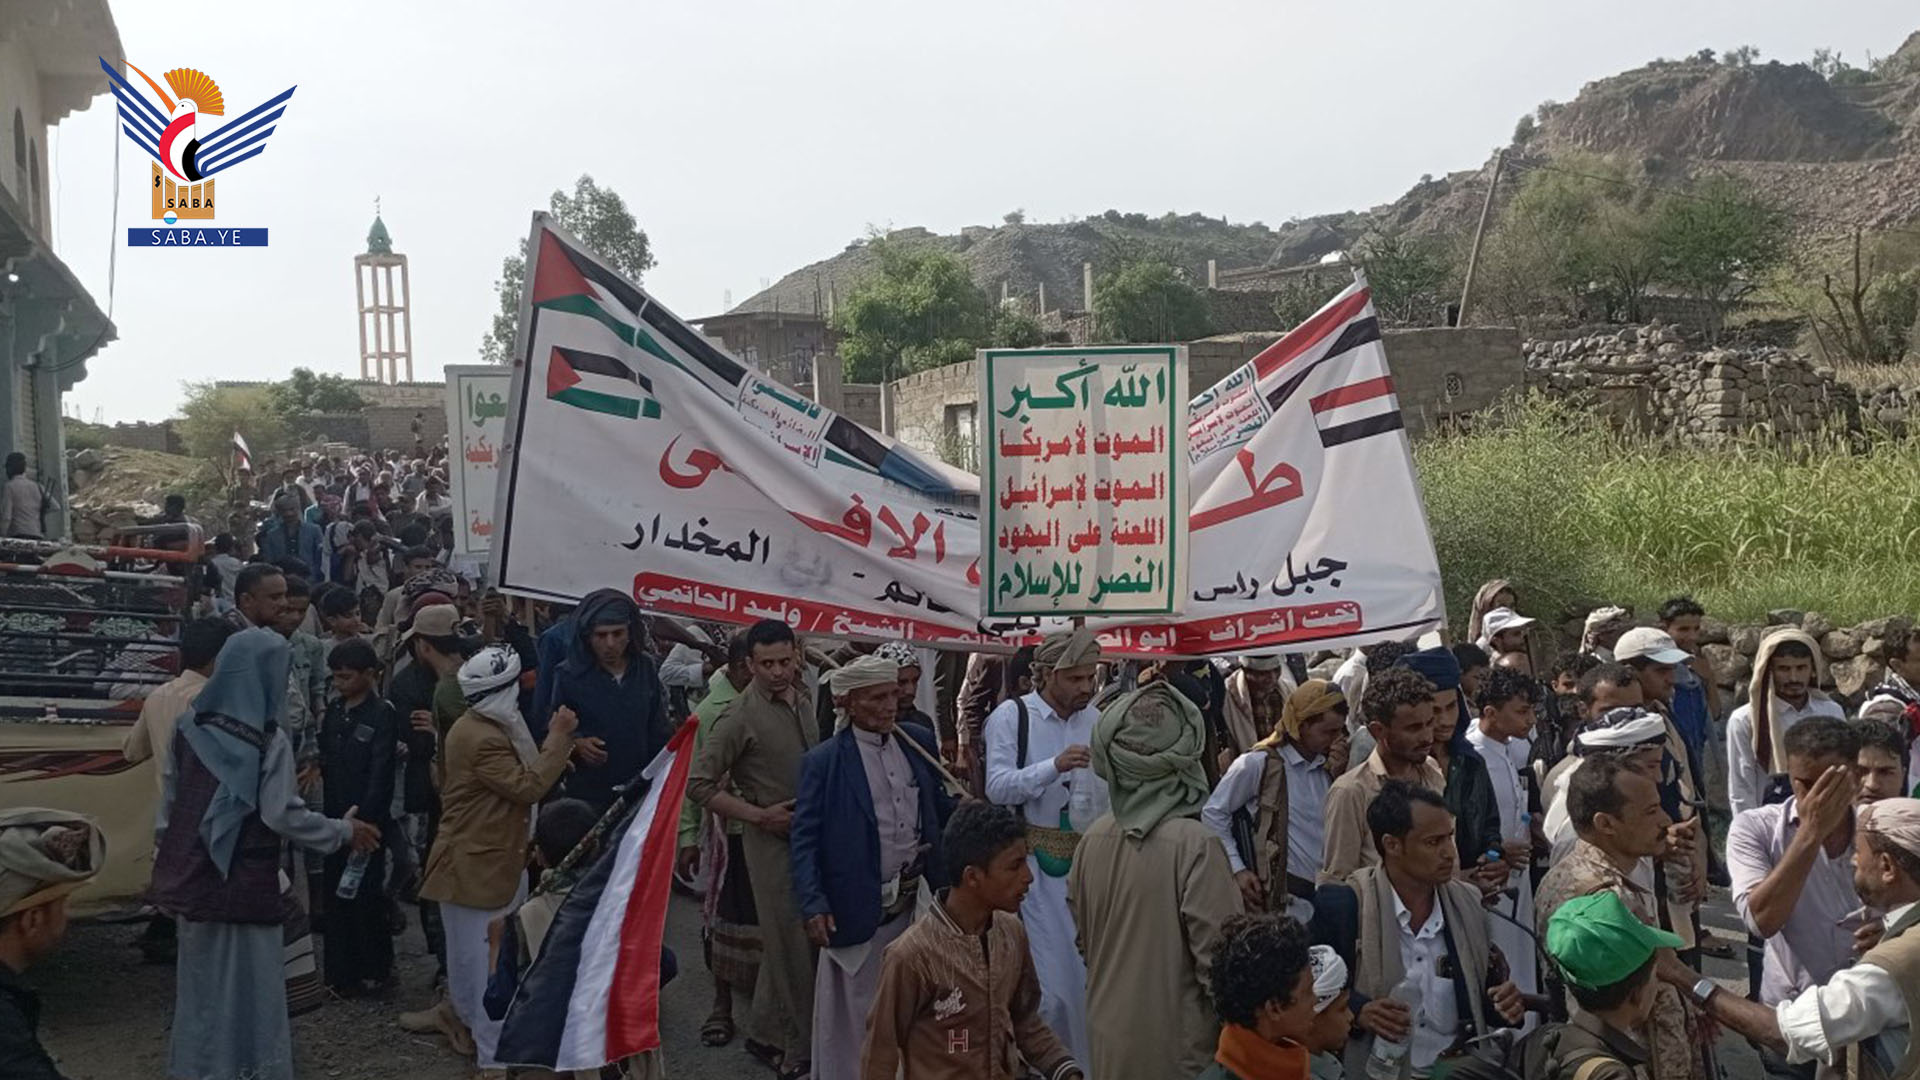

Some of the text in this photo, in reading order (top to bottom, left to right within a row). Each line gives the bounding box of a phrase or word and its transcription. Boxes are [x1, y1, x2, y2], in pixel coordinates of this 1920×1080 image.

[998, 358, 1166, 424] الله أكبر
[1094, 425, 1164, 460] الموت
[1094, 471, 1164, 507] الموت
[620, 513, 770, 565] المخدار
[999, 515, 1164, 555] اللعنة على اليهود
[998, 560, 1083, 608] للإسلام
[1088, 555, 1164, 604] النصر
[1272, 552, 1348, 596] جبل
[637, 582, 736, 612] الحاتمي
[743, 600, 801, 628] وليد
[832, 610, 914, 640] الشيخ
[1209, 609, 1295, 641] اشراف
[1302, 604, 1359, 629] تحت
[1138, 627, 1177, 651] ابو
[948, 1029, 969, 1054] H
